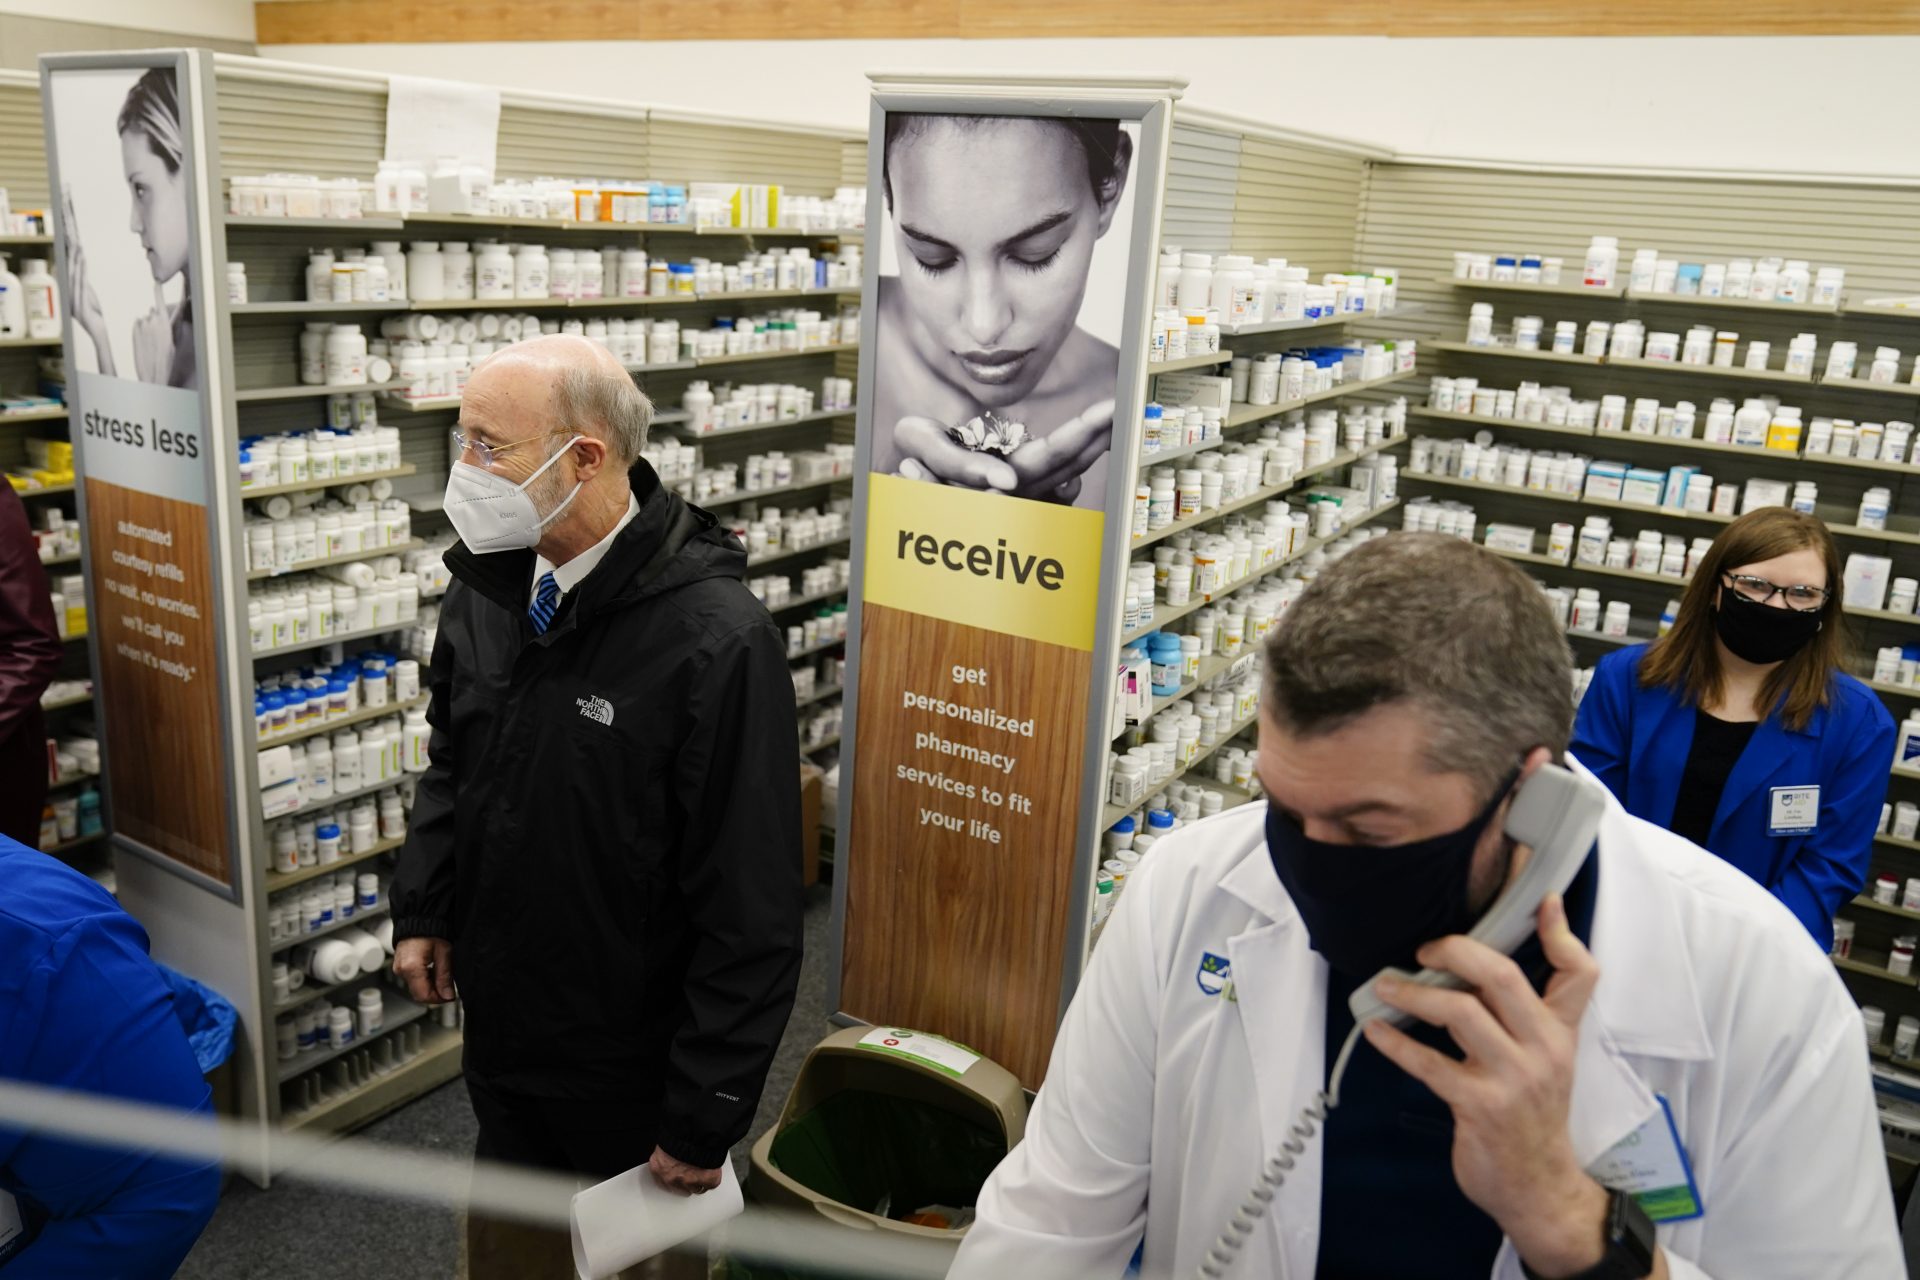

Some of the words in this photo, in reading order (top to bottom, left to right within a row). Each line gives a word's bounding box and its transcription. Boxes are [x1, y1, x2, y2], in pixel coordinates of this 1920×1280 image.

[85, 409, 144, 448] stress
[151, 418, 198, 459] less
[117, 520, 172, 548] automated
[155, 562, 184, 583] refills
[897, 529, 1064, 591] receive
[104, 578, 117, 593] no
[141, 591, 155, 606] no
[144, 623, 163, 639] call
[163, 629, 185, 647] you
[117, 643, 141, 662] when
[952, 665, 987, 686] get
[575, 697, 603, 715] NORTH
[580, 707, 601, 721] FACE
[590, 694, 606, 707] THE
[903, 690, 1034, 737] personalized
[915, 731, 1016, 774] pharmacy
[897, 763, 976, 799] services
[981, 785, 1003, 807] to
[1008, 793, 1032, 815] fit
[920, 807, 965, 832] your
[970, 818, 1001, 843] life
